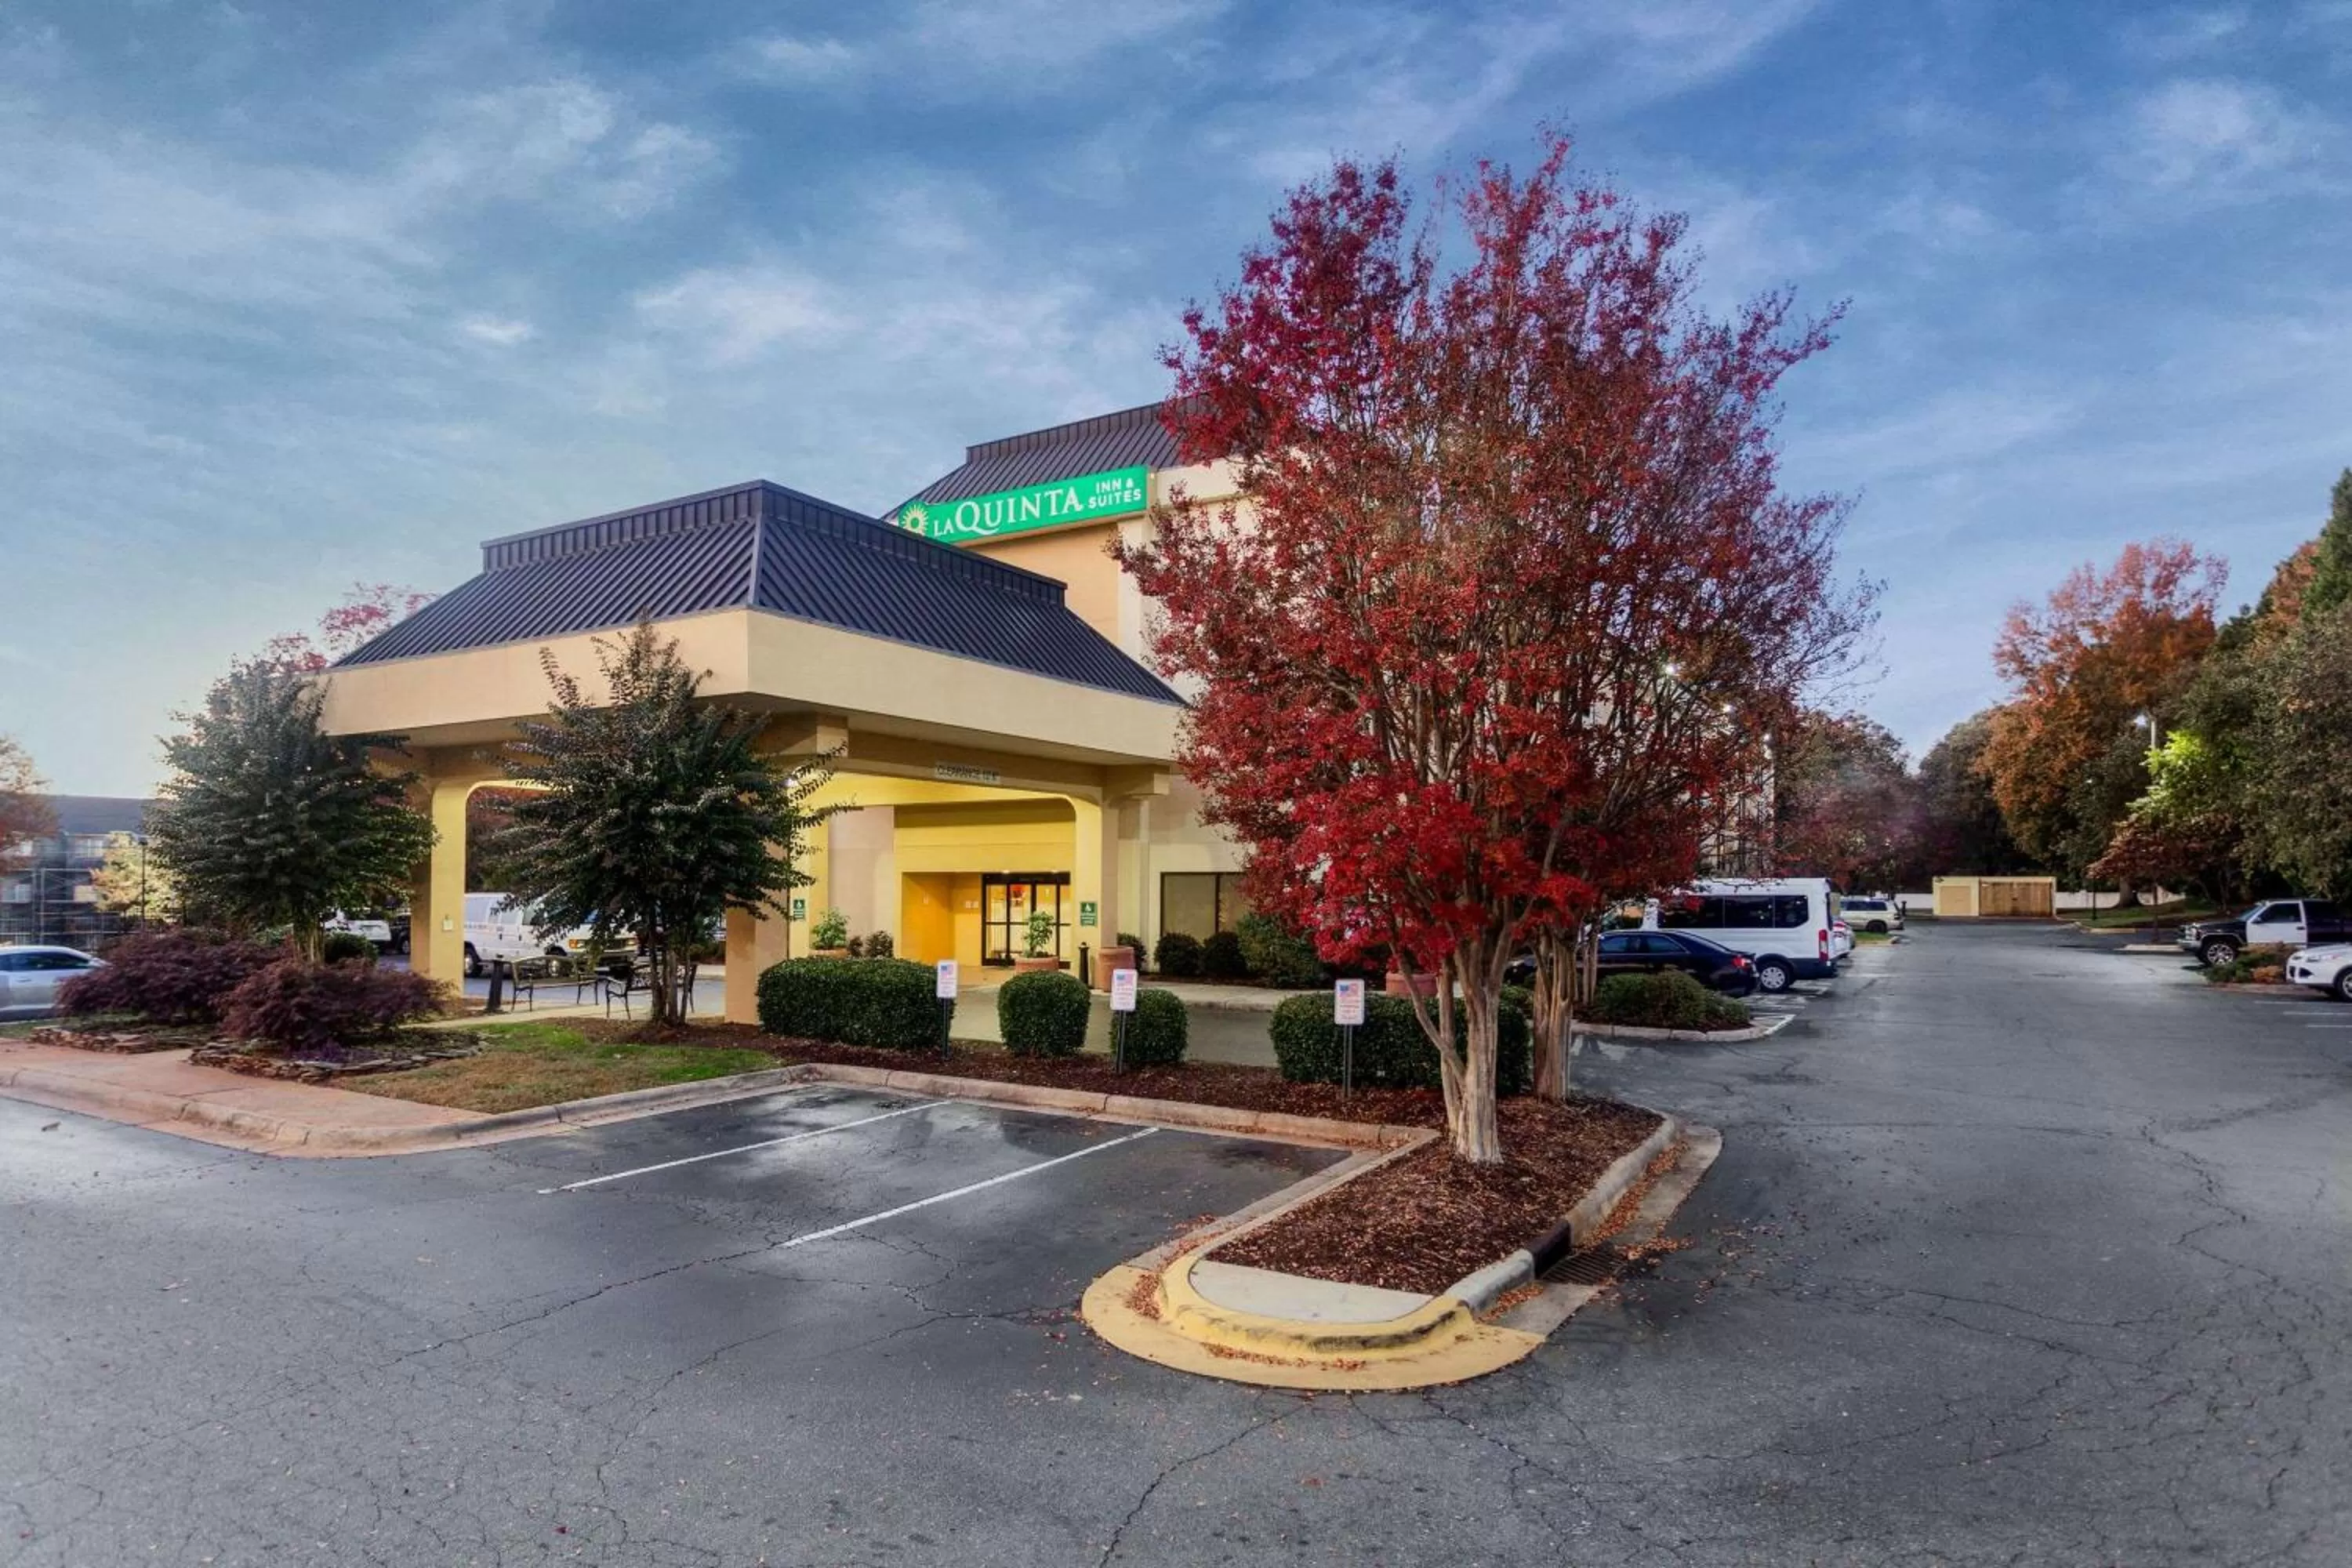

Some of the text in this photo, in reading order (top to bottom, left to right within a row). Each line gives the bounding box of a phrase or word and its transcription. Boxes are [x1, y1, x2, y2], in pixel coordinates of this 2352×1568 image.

[1095, 477, 1134, 494] INN &
[1088, 488, 1142, 509] SUITES
[933, 486, 1083, 537] LA QUINTA
